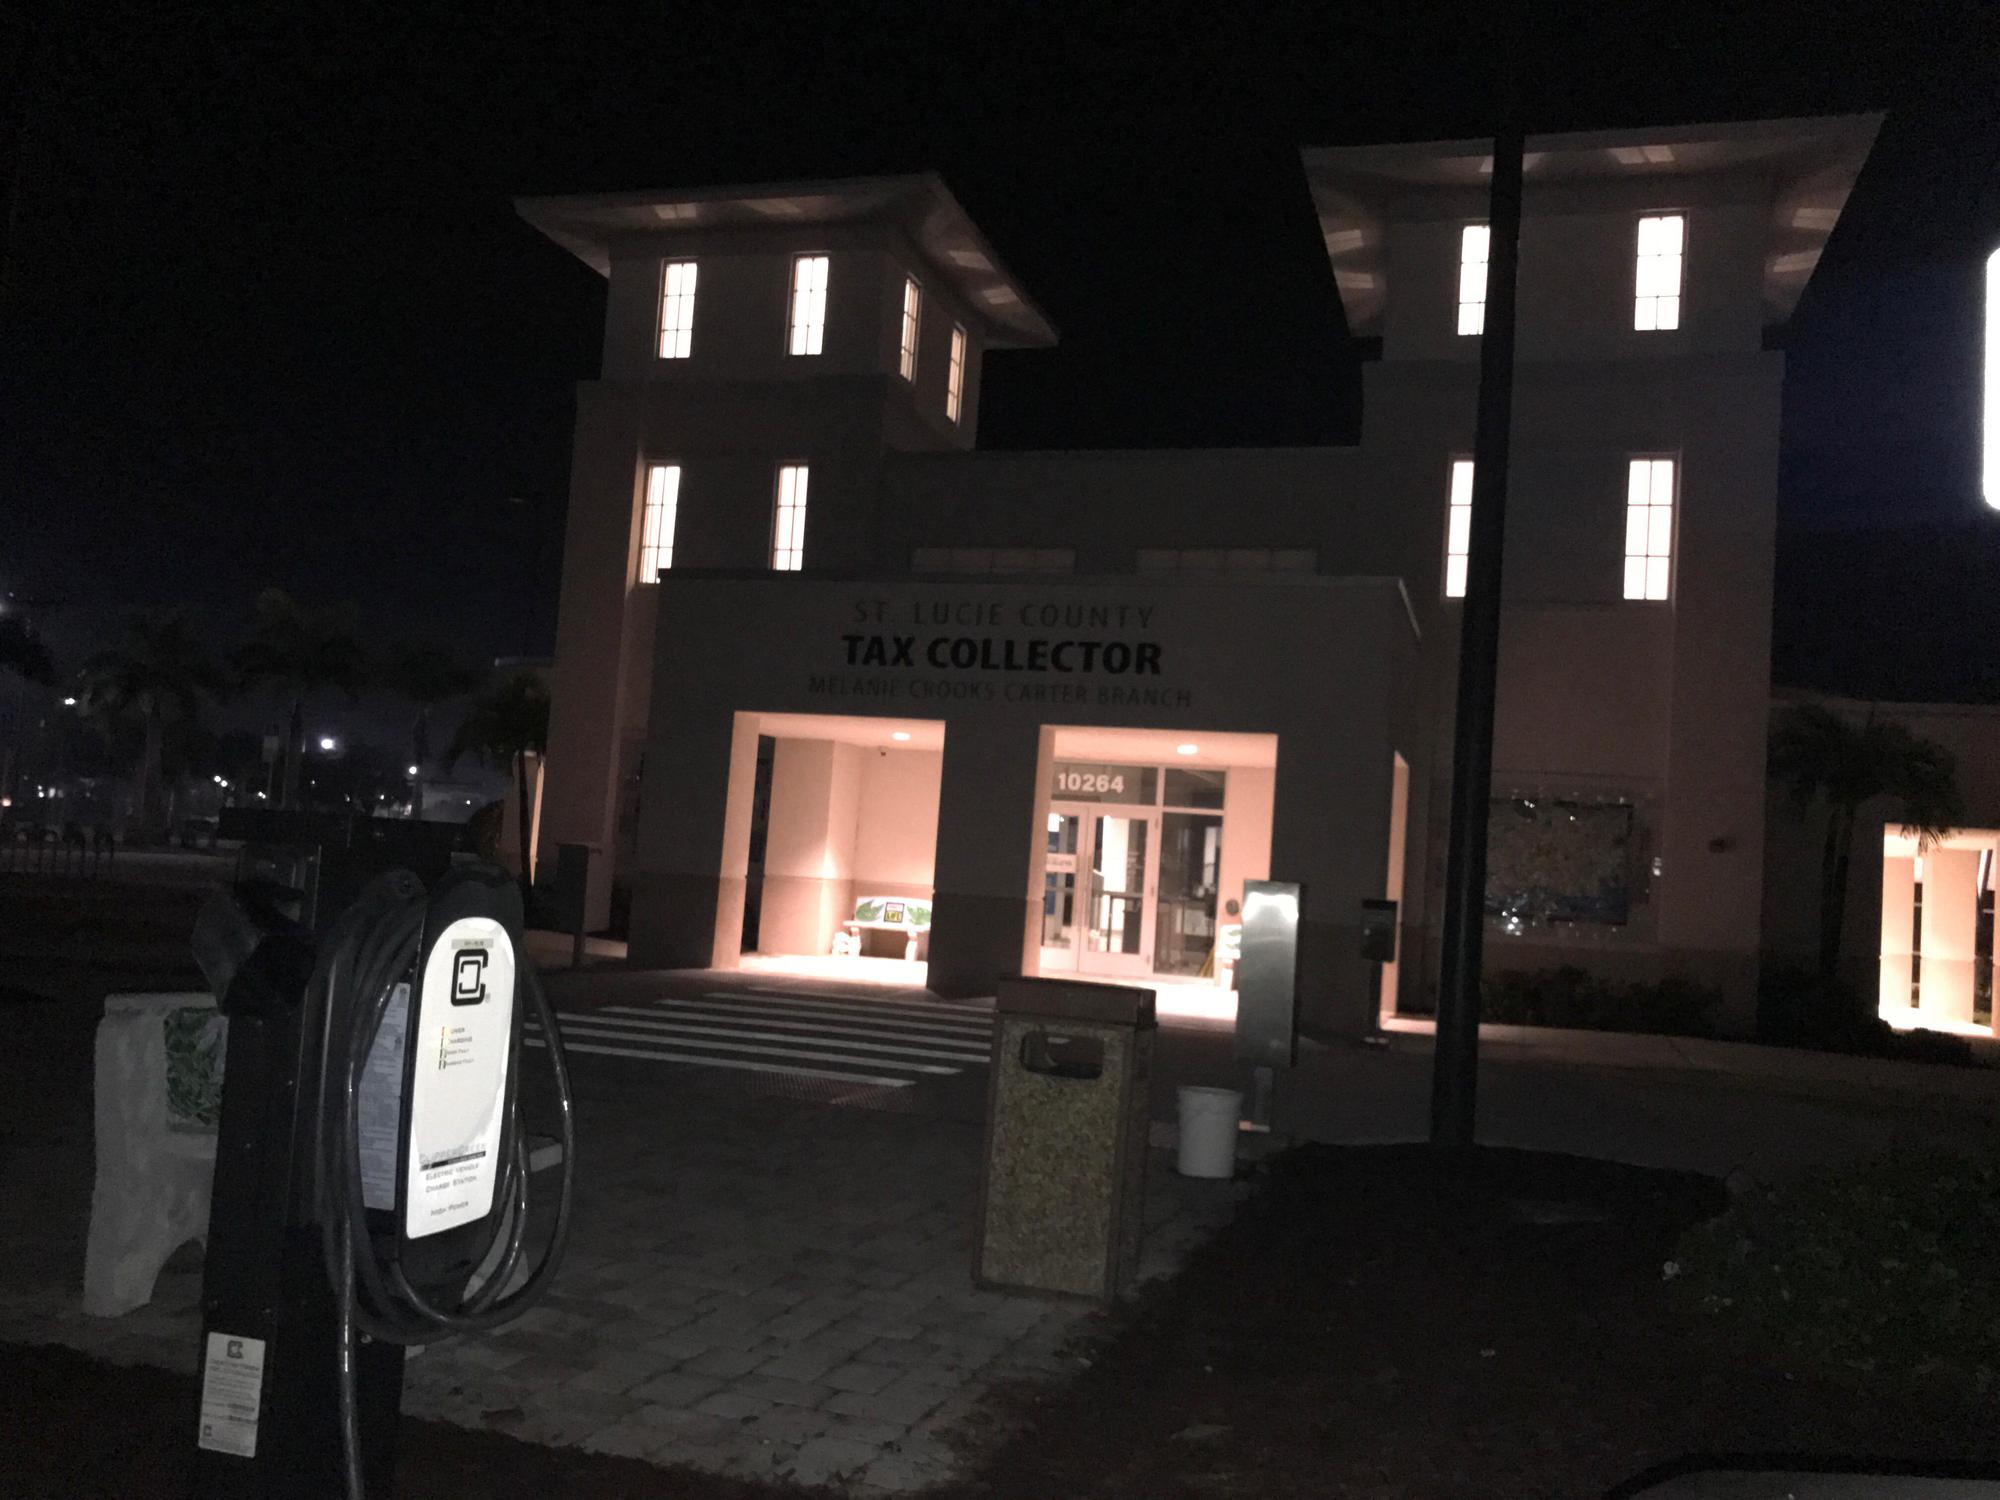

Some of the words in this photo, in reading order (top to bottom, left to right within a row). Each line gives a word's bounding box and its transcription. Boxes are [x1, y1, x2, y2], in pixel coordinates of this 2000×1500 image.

[855, 600, 896, 624] ST.
[913, 601, 1002, 626] LUCIE
[1020, 603, 1155, 629] COUNTY
[842, 634, 916, 667] TAX
[926, 637, 1162, 675] COLLECTOR
[807, 675, 899, 698] MELANIE
[909, 678, 994, 702] CROOKS
[1004, 682, 1088, 705] CARTER
[1098, 685, 1191, 708] BRANCH
[1058, 772, 1125, 794] 10264
